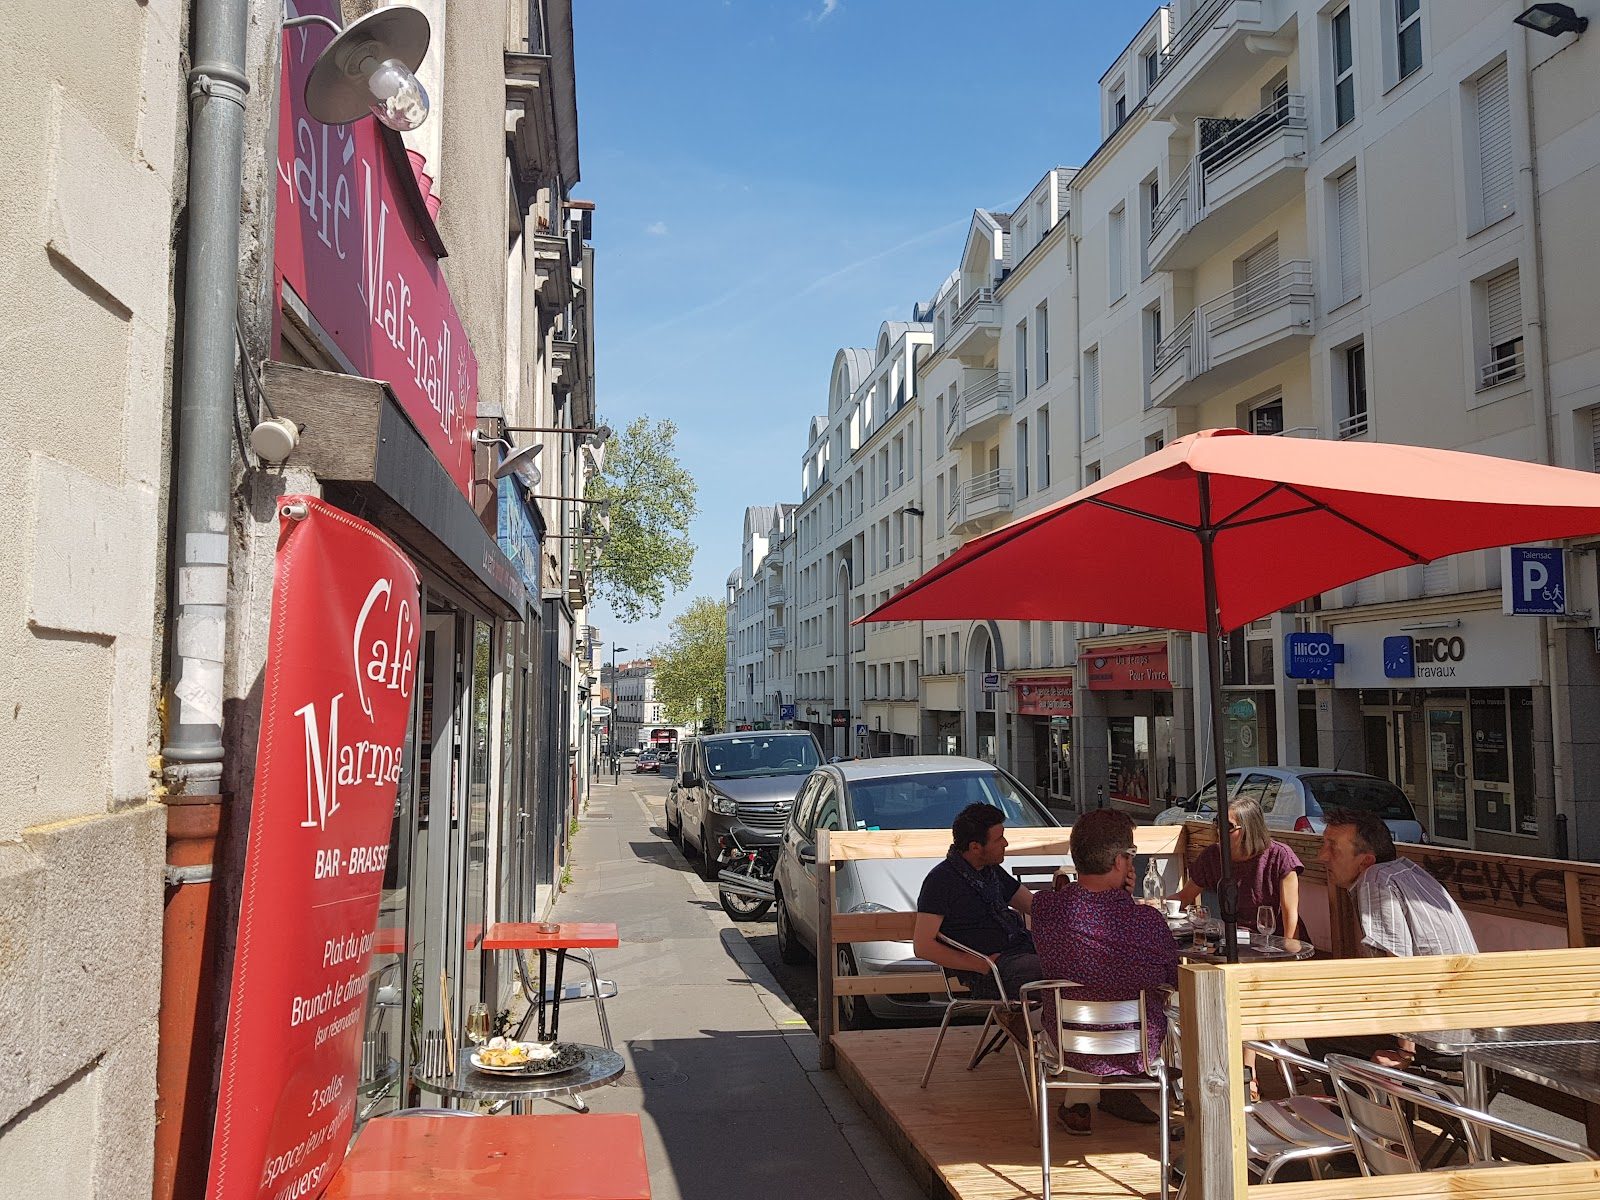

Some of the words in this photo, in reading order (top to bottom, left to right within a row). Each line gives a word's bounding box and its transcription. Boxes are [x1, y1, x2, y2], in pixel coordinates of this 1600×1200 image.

[357, 158, 456, 446] Marmaille
[1522, 551, 1552, 559] Talensac
[1523, 561, 1548, 601] P
[353, 578, 413, 723] Café
[1129, 669, 1145, 681] Pour
[1417, 666, 1456, 678] travaux
[315, 848, 340, 880] BAR
[322, 936, 344, 969] Plat
[345, 932, 359, 960] du
[356, 929, 375, 963] jour
[291, 984, 332, 1027] Brunch
[333, 980, 344, 1008] le
[314, 1025, 329, 1050] (sur
[307, 1089, 319, 1117] 3
[317, 1074, 344, 1112] salles
[298, 1123, 329, 1167] jeux
